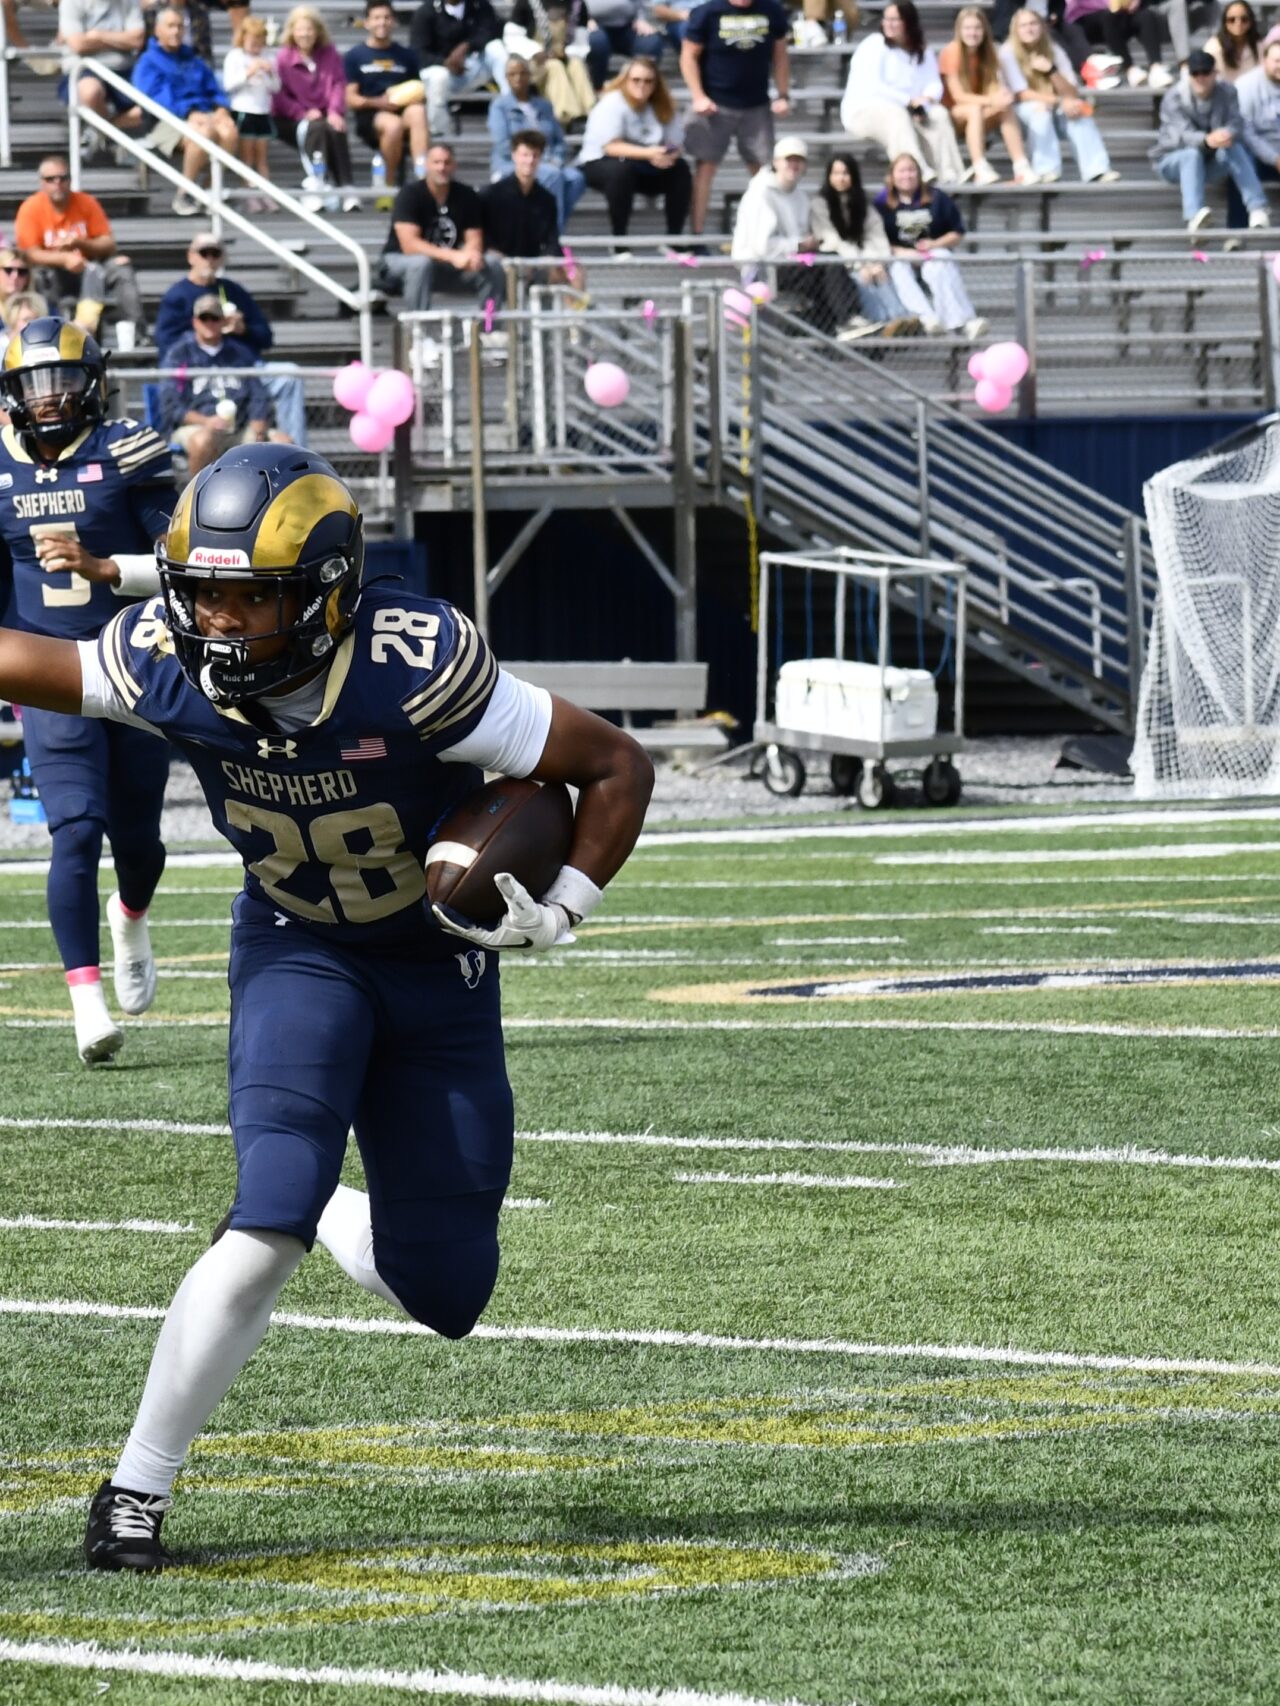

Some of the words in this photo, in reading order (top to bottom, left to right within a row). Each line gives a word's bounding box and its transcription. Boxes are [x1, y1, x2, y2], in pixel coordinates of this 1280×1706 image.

[12, 489, 86, 518] SHEPHERD
[194, 552, 240, 565] Riddell
[370, 607, 441, 671] 28
[221, 760, 358, 806] SHEPHERD
[224, 799, 427, 925] 28
